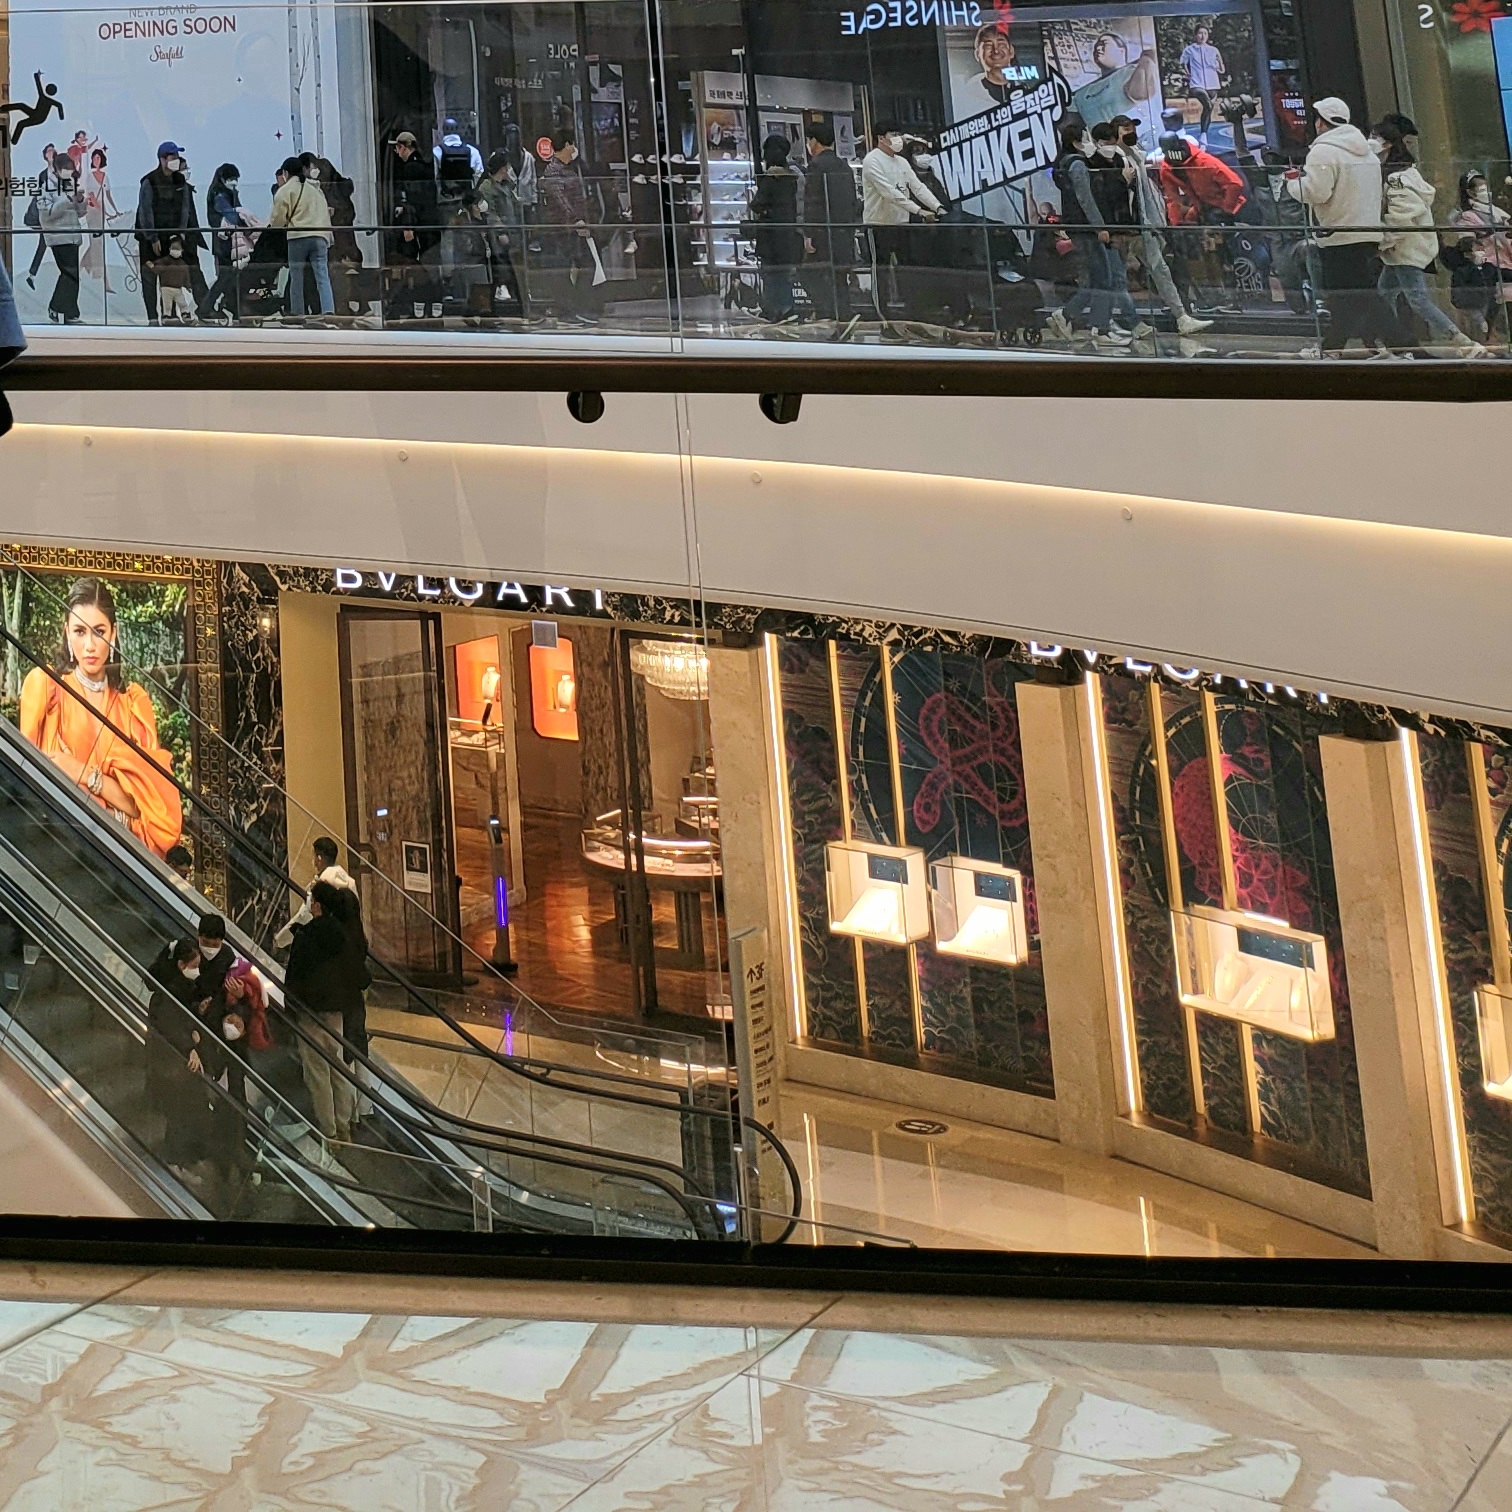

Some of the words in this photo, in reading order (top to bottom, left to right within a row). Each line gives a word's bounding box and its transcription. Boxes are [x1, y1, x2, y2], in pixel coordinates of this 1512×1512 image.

[158, 3, 197, 17] BRAND
[98, 19, 178, 40] OPENING
[183, 15, 237, 35] SOON
[1010, 81, 1056, 115] 움직임
[335, 567, 603, 610] BVLGARI
